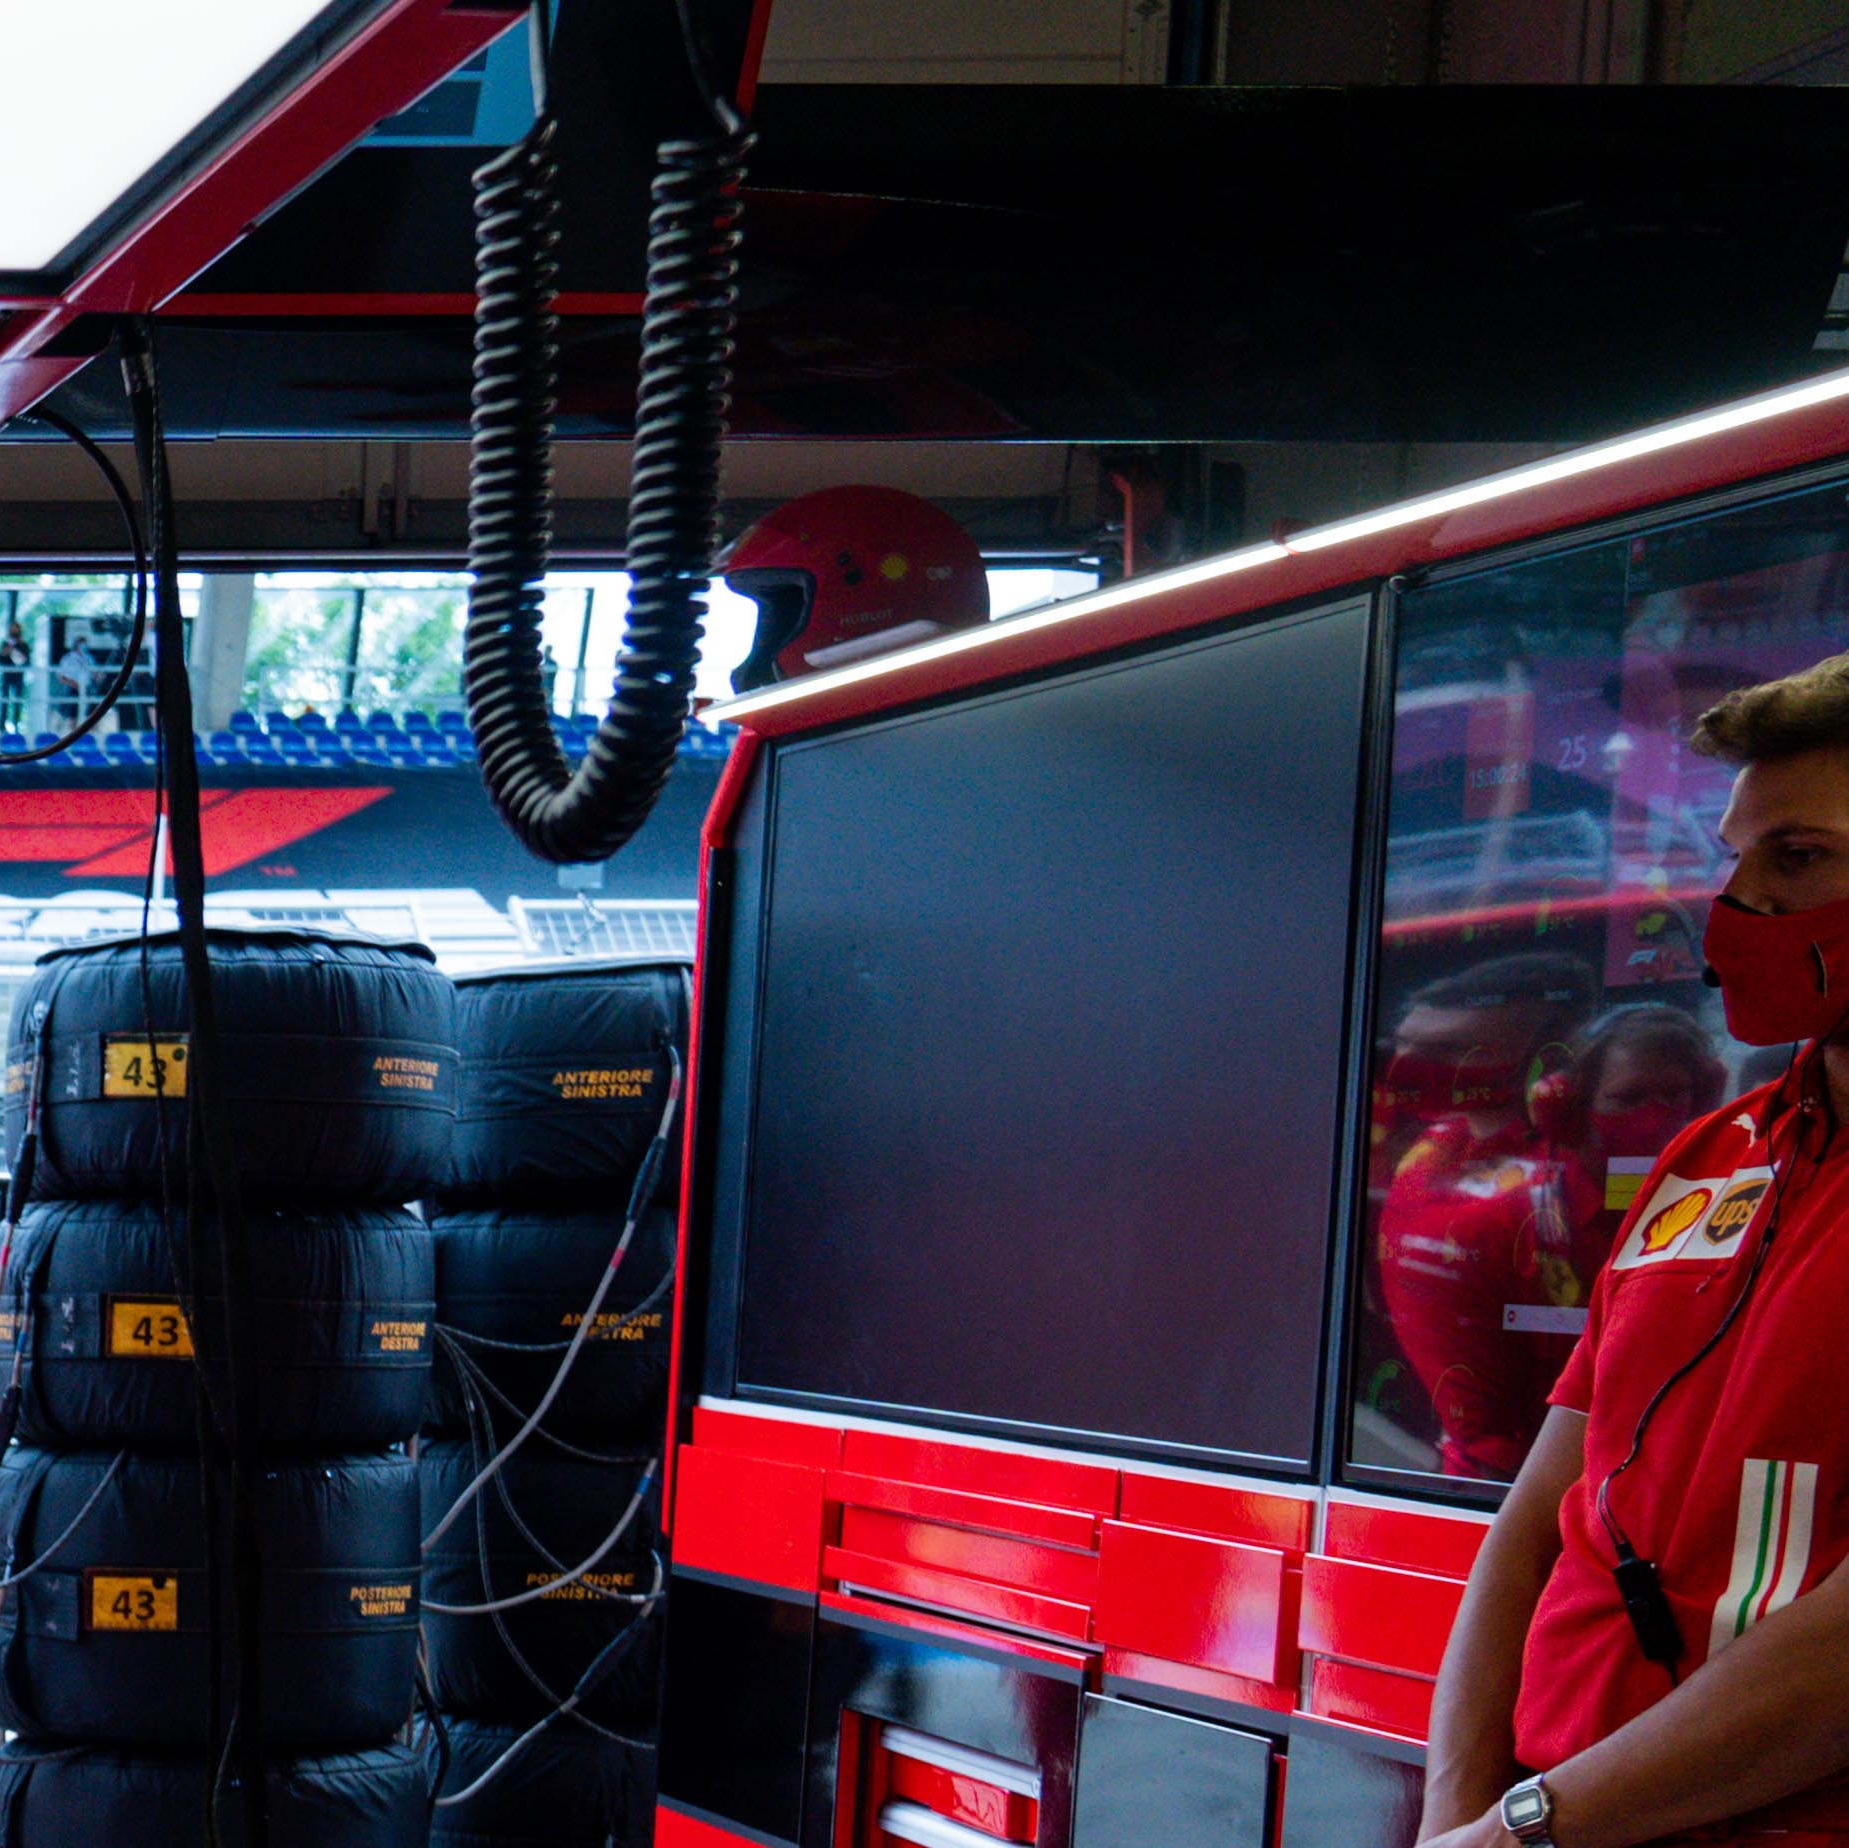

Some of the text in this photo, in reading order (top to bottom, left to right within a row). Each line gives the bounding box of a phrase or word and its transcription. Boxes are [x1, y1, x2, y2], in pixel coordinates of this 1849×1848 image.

[122, 1055, 168, 1089] 43
[372, 1055, 440, 1075] ANTERIORE
[380, 1071, 435, 1091] SINISTRA
[552, 1068, 654, 1085] ANTERIORE
[561, 1083, 643, 1099] SINISTRA
[1710, 1196, 1759, 1237] ups
[131, 1315, 179, 1347] 43
[371, 1320, 426, 1339] ANTERIORE
[379, 1335, 420, 1352] DESTRA
[350, 1585, 413, 1602] POSTERIORE
[111, 1589, 156, 1622] 43
[360, 1599, 407, 1616] SINISTRA
